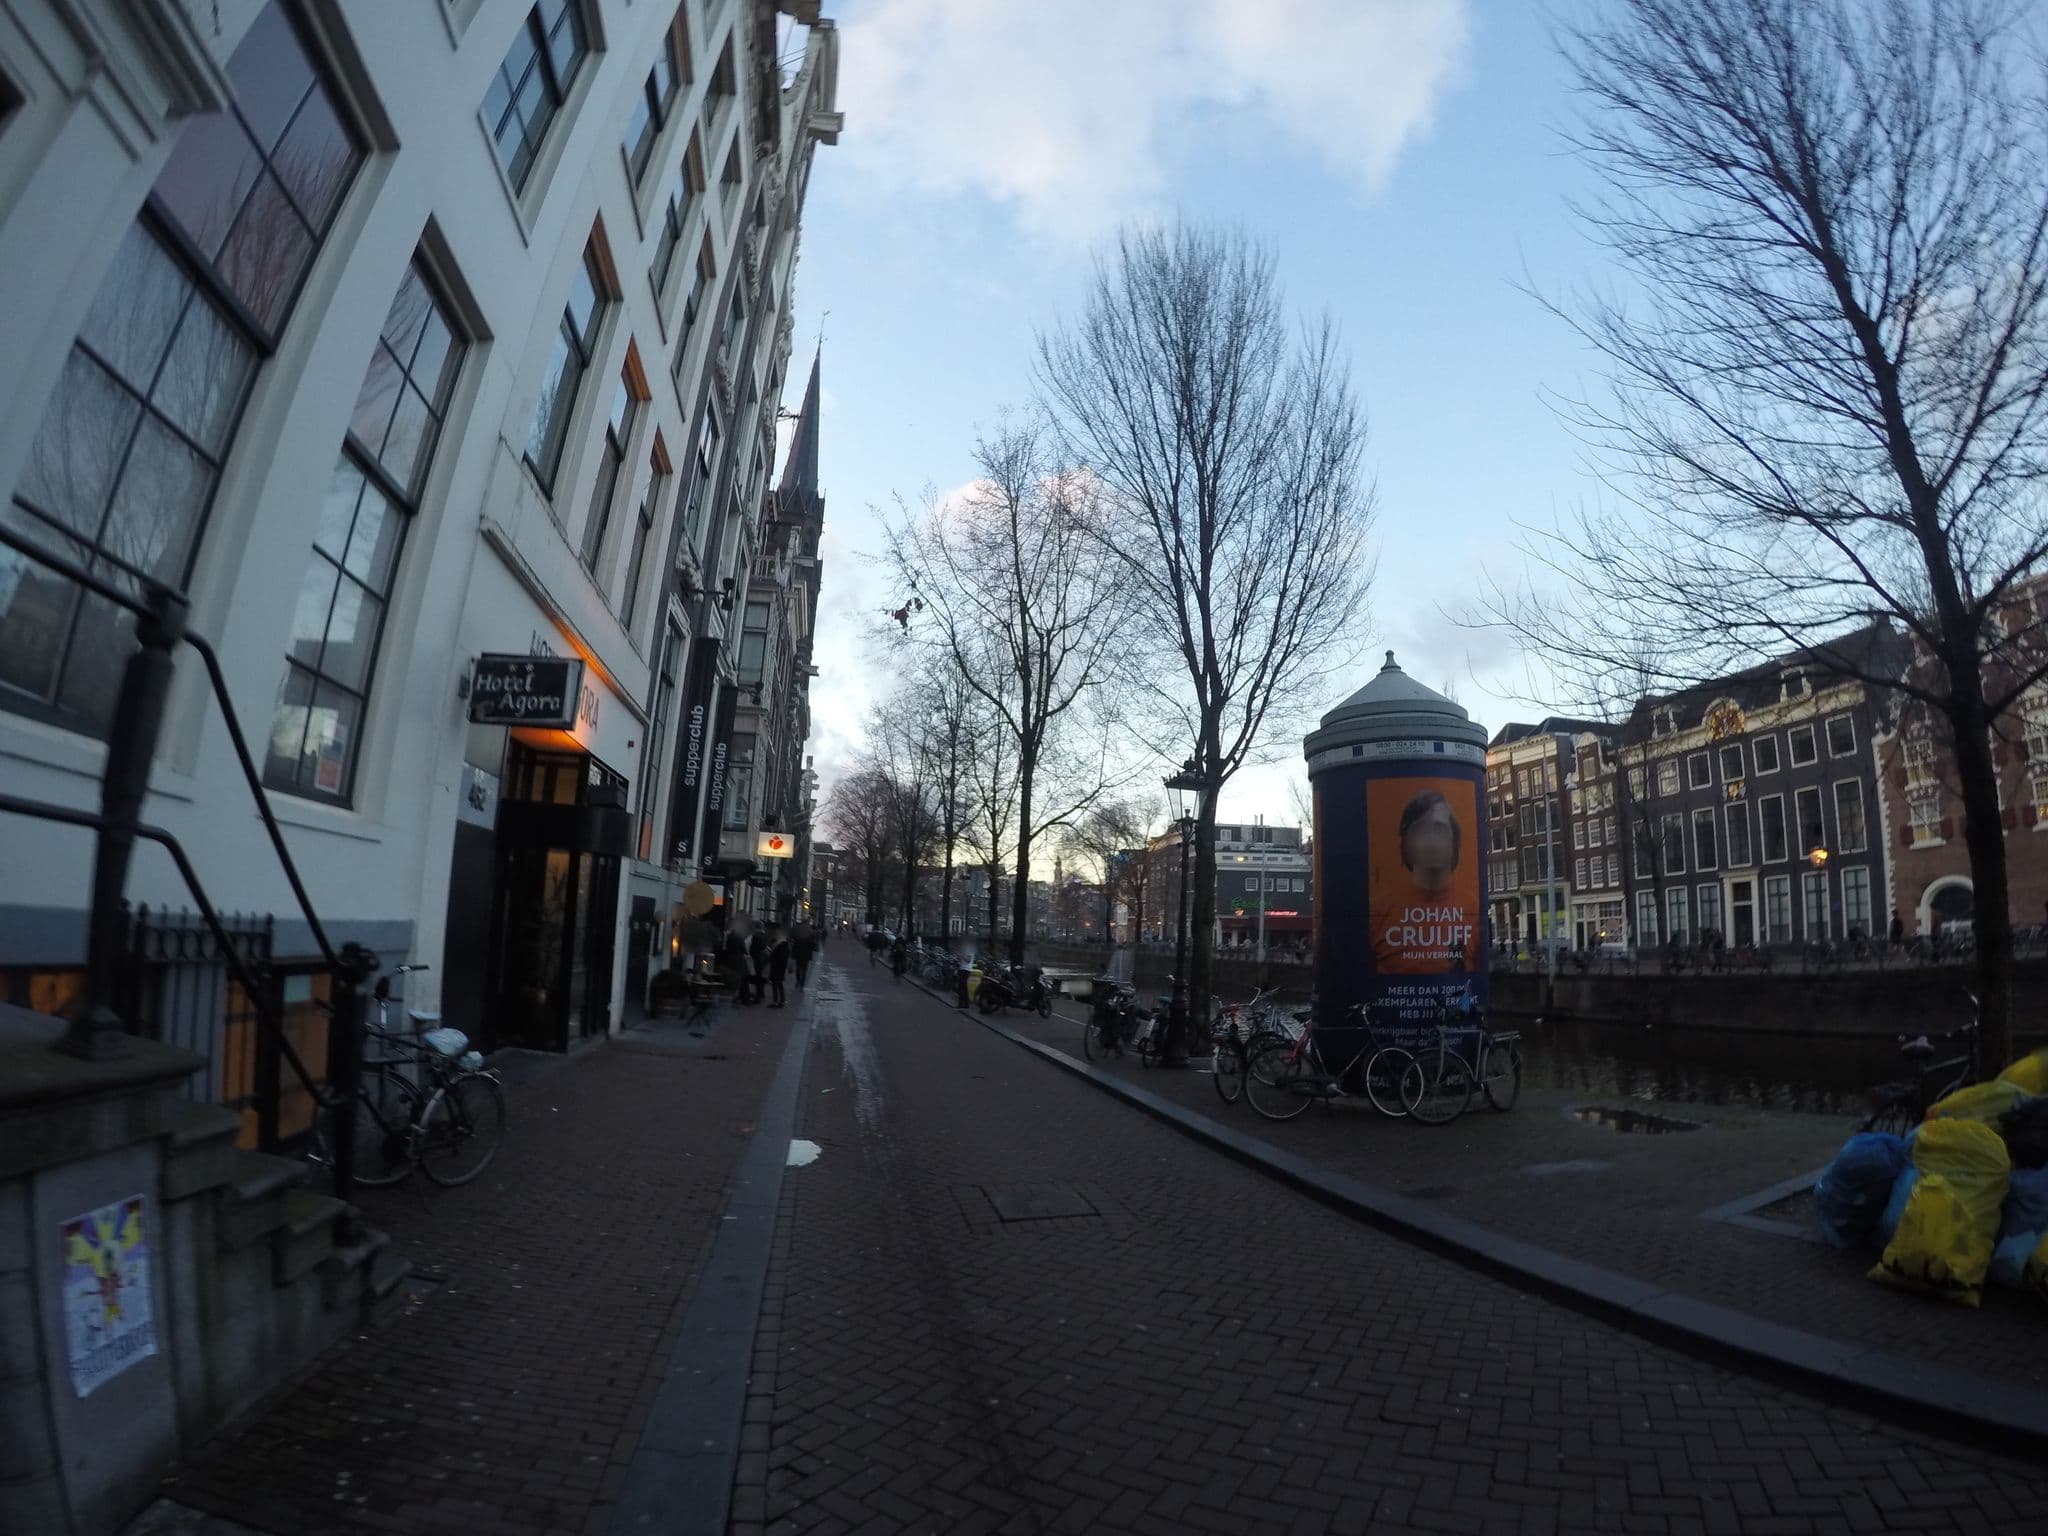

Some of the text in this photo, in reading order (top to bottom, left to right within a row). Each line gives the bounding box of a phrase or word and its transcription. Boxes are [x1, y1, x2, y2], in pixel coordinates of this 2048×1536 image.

[474, 673, 537, 693] Hotel
[499, 691, 562, 718] Agora
[684, 704, 705, 787] supperclub
[710, 742, 728, 811] supperclub
[1400, 907, 1464, 923] JOHAN
[1385, 925, 1473, 947] CRUIJFF
[1402, 951, 1463, 960] MIJN VERHAAL
[1388, 986, 1415, 996] MEER
[1418, 986, 1439, 995] DAN
